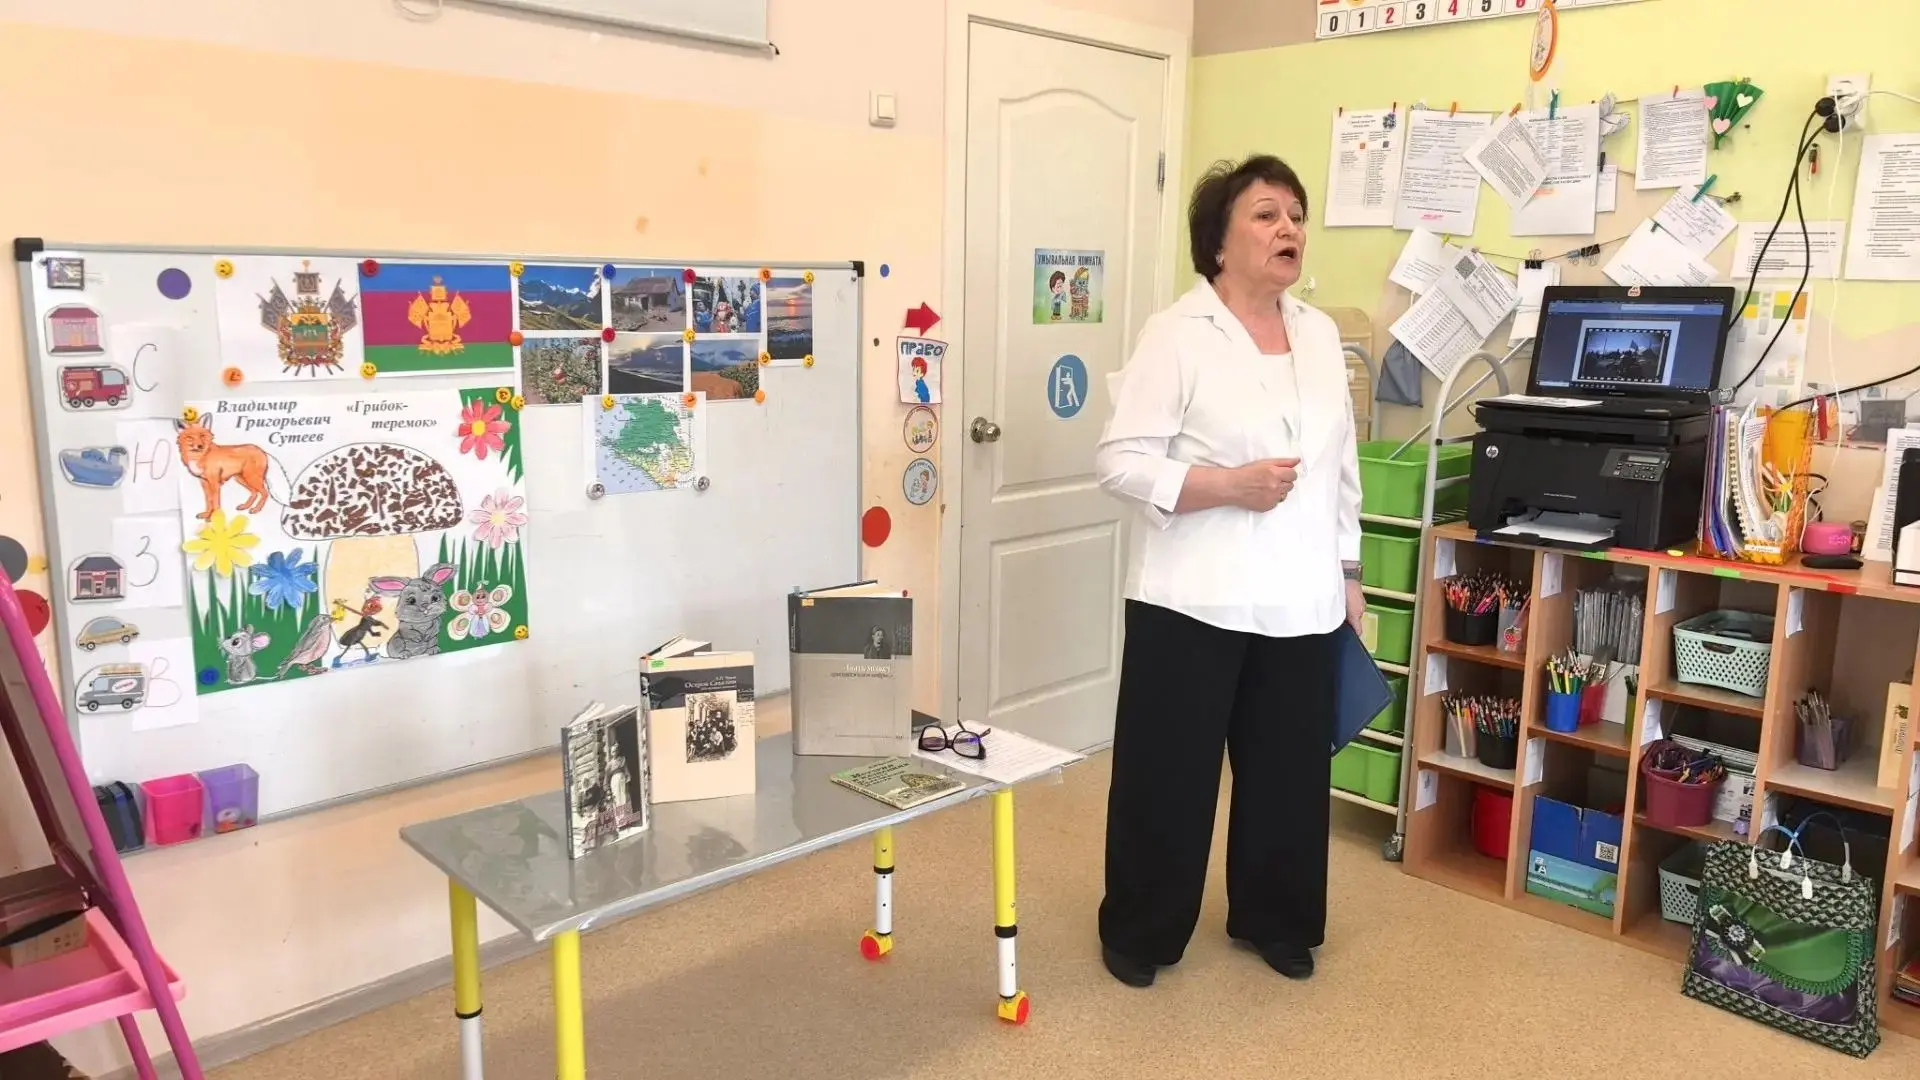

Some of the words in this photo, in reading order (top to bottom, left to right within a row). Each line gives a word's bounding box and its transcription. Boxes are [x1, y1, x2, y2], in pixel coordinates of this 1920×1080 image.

[1329, 15, 1339, 32] 0
[1358, 11, 1365, 28] 1
[1385, 7, 1395, 24] 2
[1415, 3, 1426, 20] 3
[1447, 0, 1458, 15] 4
[1037, 254, 1075, 266] УМЫВАЛЬНАЯ
[1077, 255, 1102, 267] КОМНАТА
[216, 400, 298, 413] Владимир
[346, 400, 409, 415] «Грибок-
[235, 415, 332, 431] Григорьевич
[371, 418, 438, 432] теремок»
[268, 431, 324, 447] Сутеев
[133, 438, 171, 483] Ю
